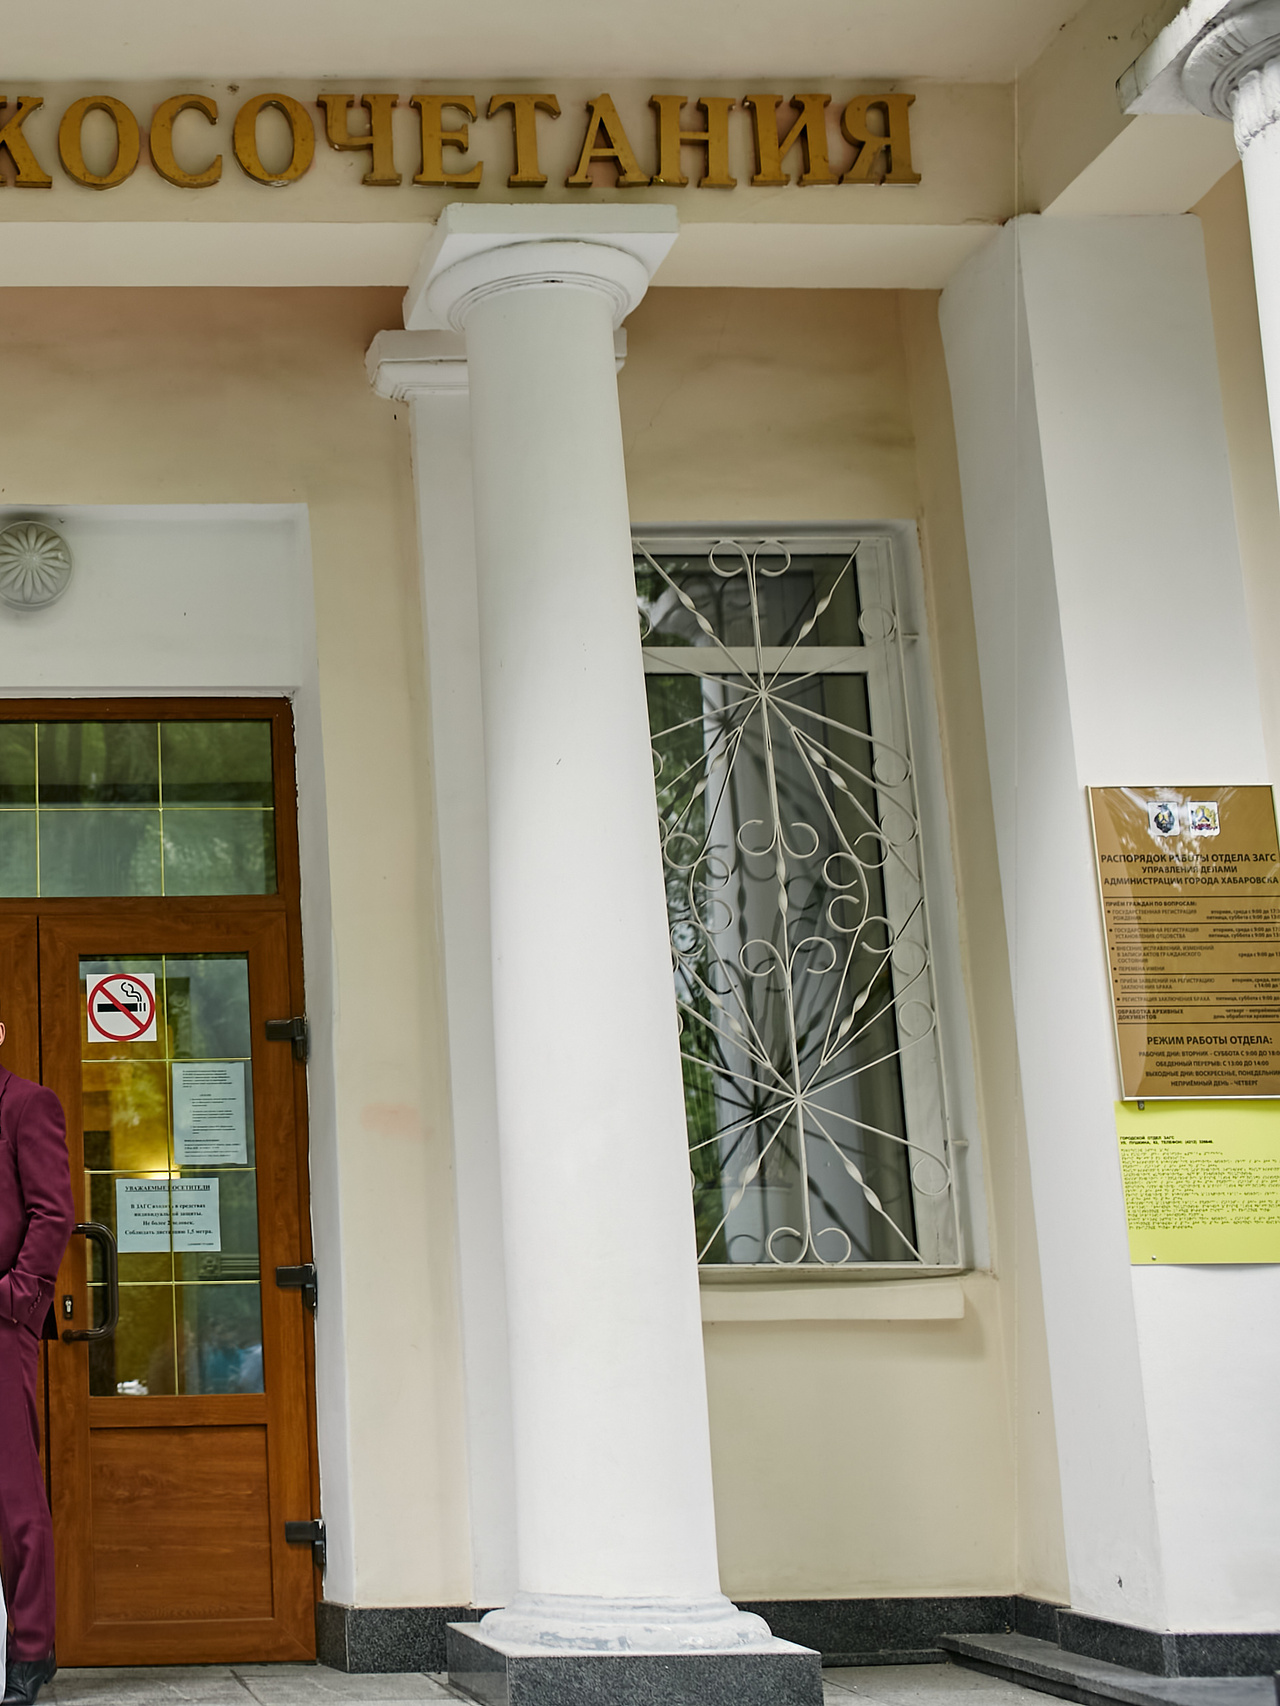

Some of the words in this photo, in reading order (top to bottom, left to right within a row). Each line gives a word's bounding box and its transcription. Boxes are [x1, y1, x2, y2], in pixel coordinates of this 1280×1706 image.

[1101, 854, 1167, 864] РАСПОРЯДОК
[1168, 853, 1209, 863] РАБОТЫ
[1211, 853, 1251, 863] ОТДЕЛА
[1252, 853, 1276, 862] ЗАГС
[1141, 866, 1198, 874] УПРАВЛЕНИЯ
[1200, 865, 1238, 875] ДЕЛАМИ
[1104, 877, 1183, 886] АДМИНИСТРАЦИИ
[1184, 876, 1219, 886] ГОРОДА
[1220, 876, 1279, 885] ХАБАРОВСКА
[1147, 1036, 1185, 1045] РЕЖИМ
[1186, 1036, 1228, 1045] РАБОТЫ
[1229, 1035, 1273, 1046] ОТДЕЛА:
